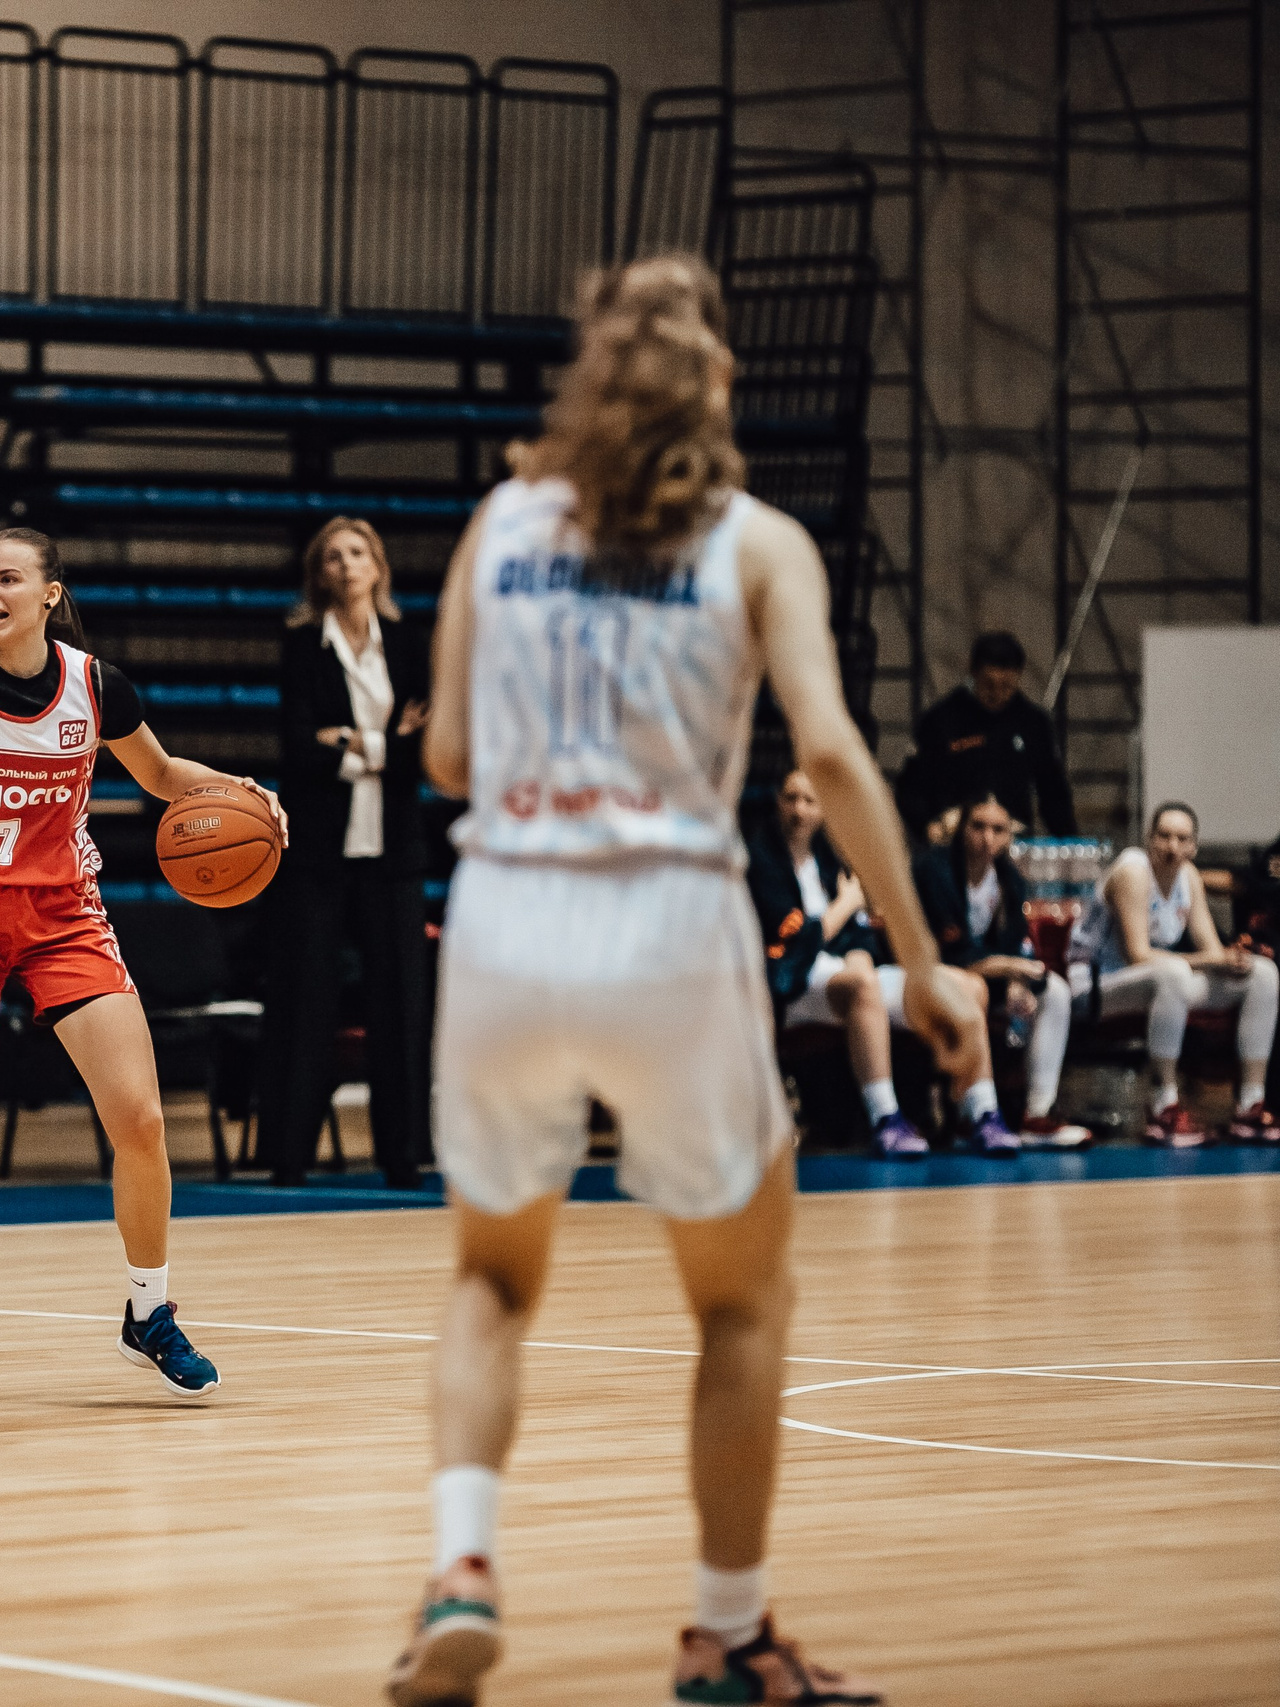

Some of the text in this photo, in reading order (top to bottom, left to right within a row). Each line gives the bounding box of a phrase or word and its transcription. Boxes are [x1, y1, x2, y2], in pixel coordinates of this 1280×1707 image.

[61, 722, 86, 735] FON
[61, 734, 85, 747] BET
[52, 768, 77, 780] КЛУБ
